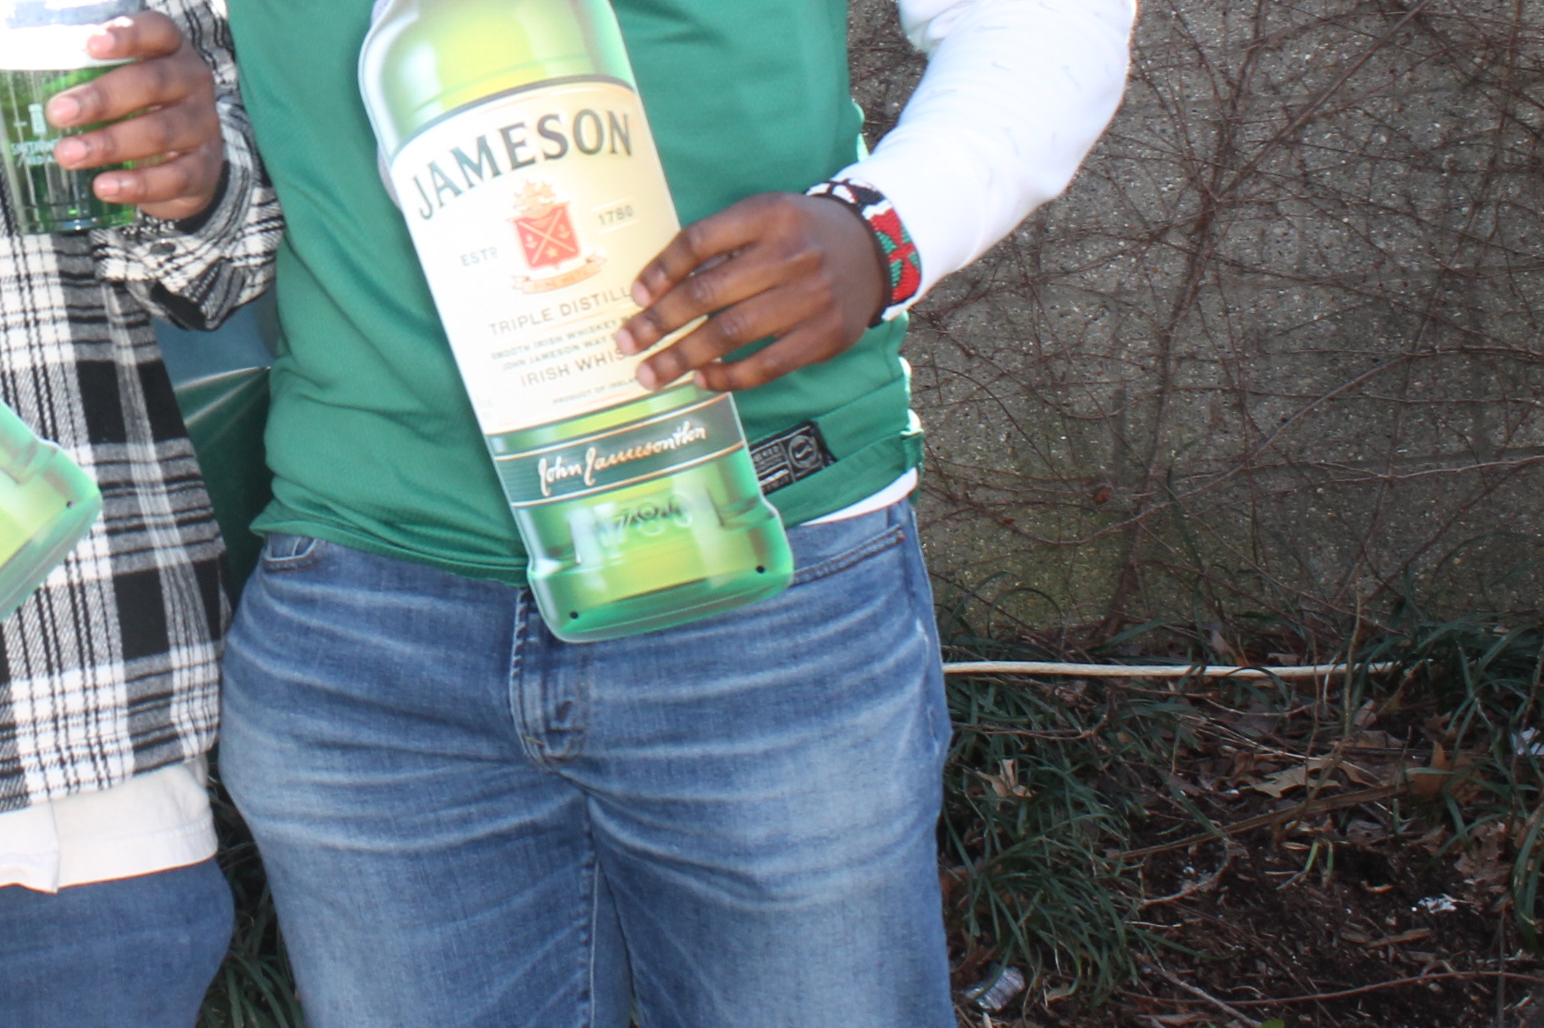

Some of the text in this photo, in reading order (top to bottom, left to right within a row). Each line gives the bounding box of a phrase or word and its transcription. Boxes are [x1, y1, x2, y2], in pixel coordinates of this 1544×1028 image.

[411, 107, 634, 221] JAMESON
[597, 204, 634, 226] 1780
[489, 286, 632, 336] TRIPLE DISTILL
[520, 347, 626, 387] IRISH WHIS
[537, 456, 583, 497] John
